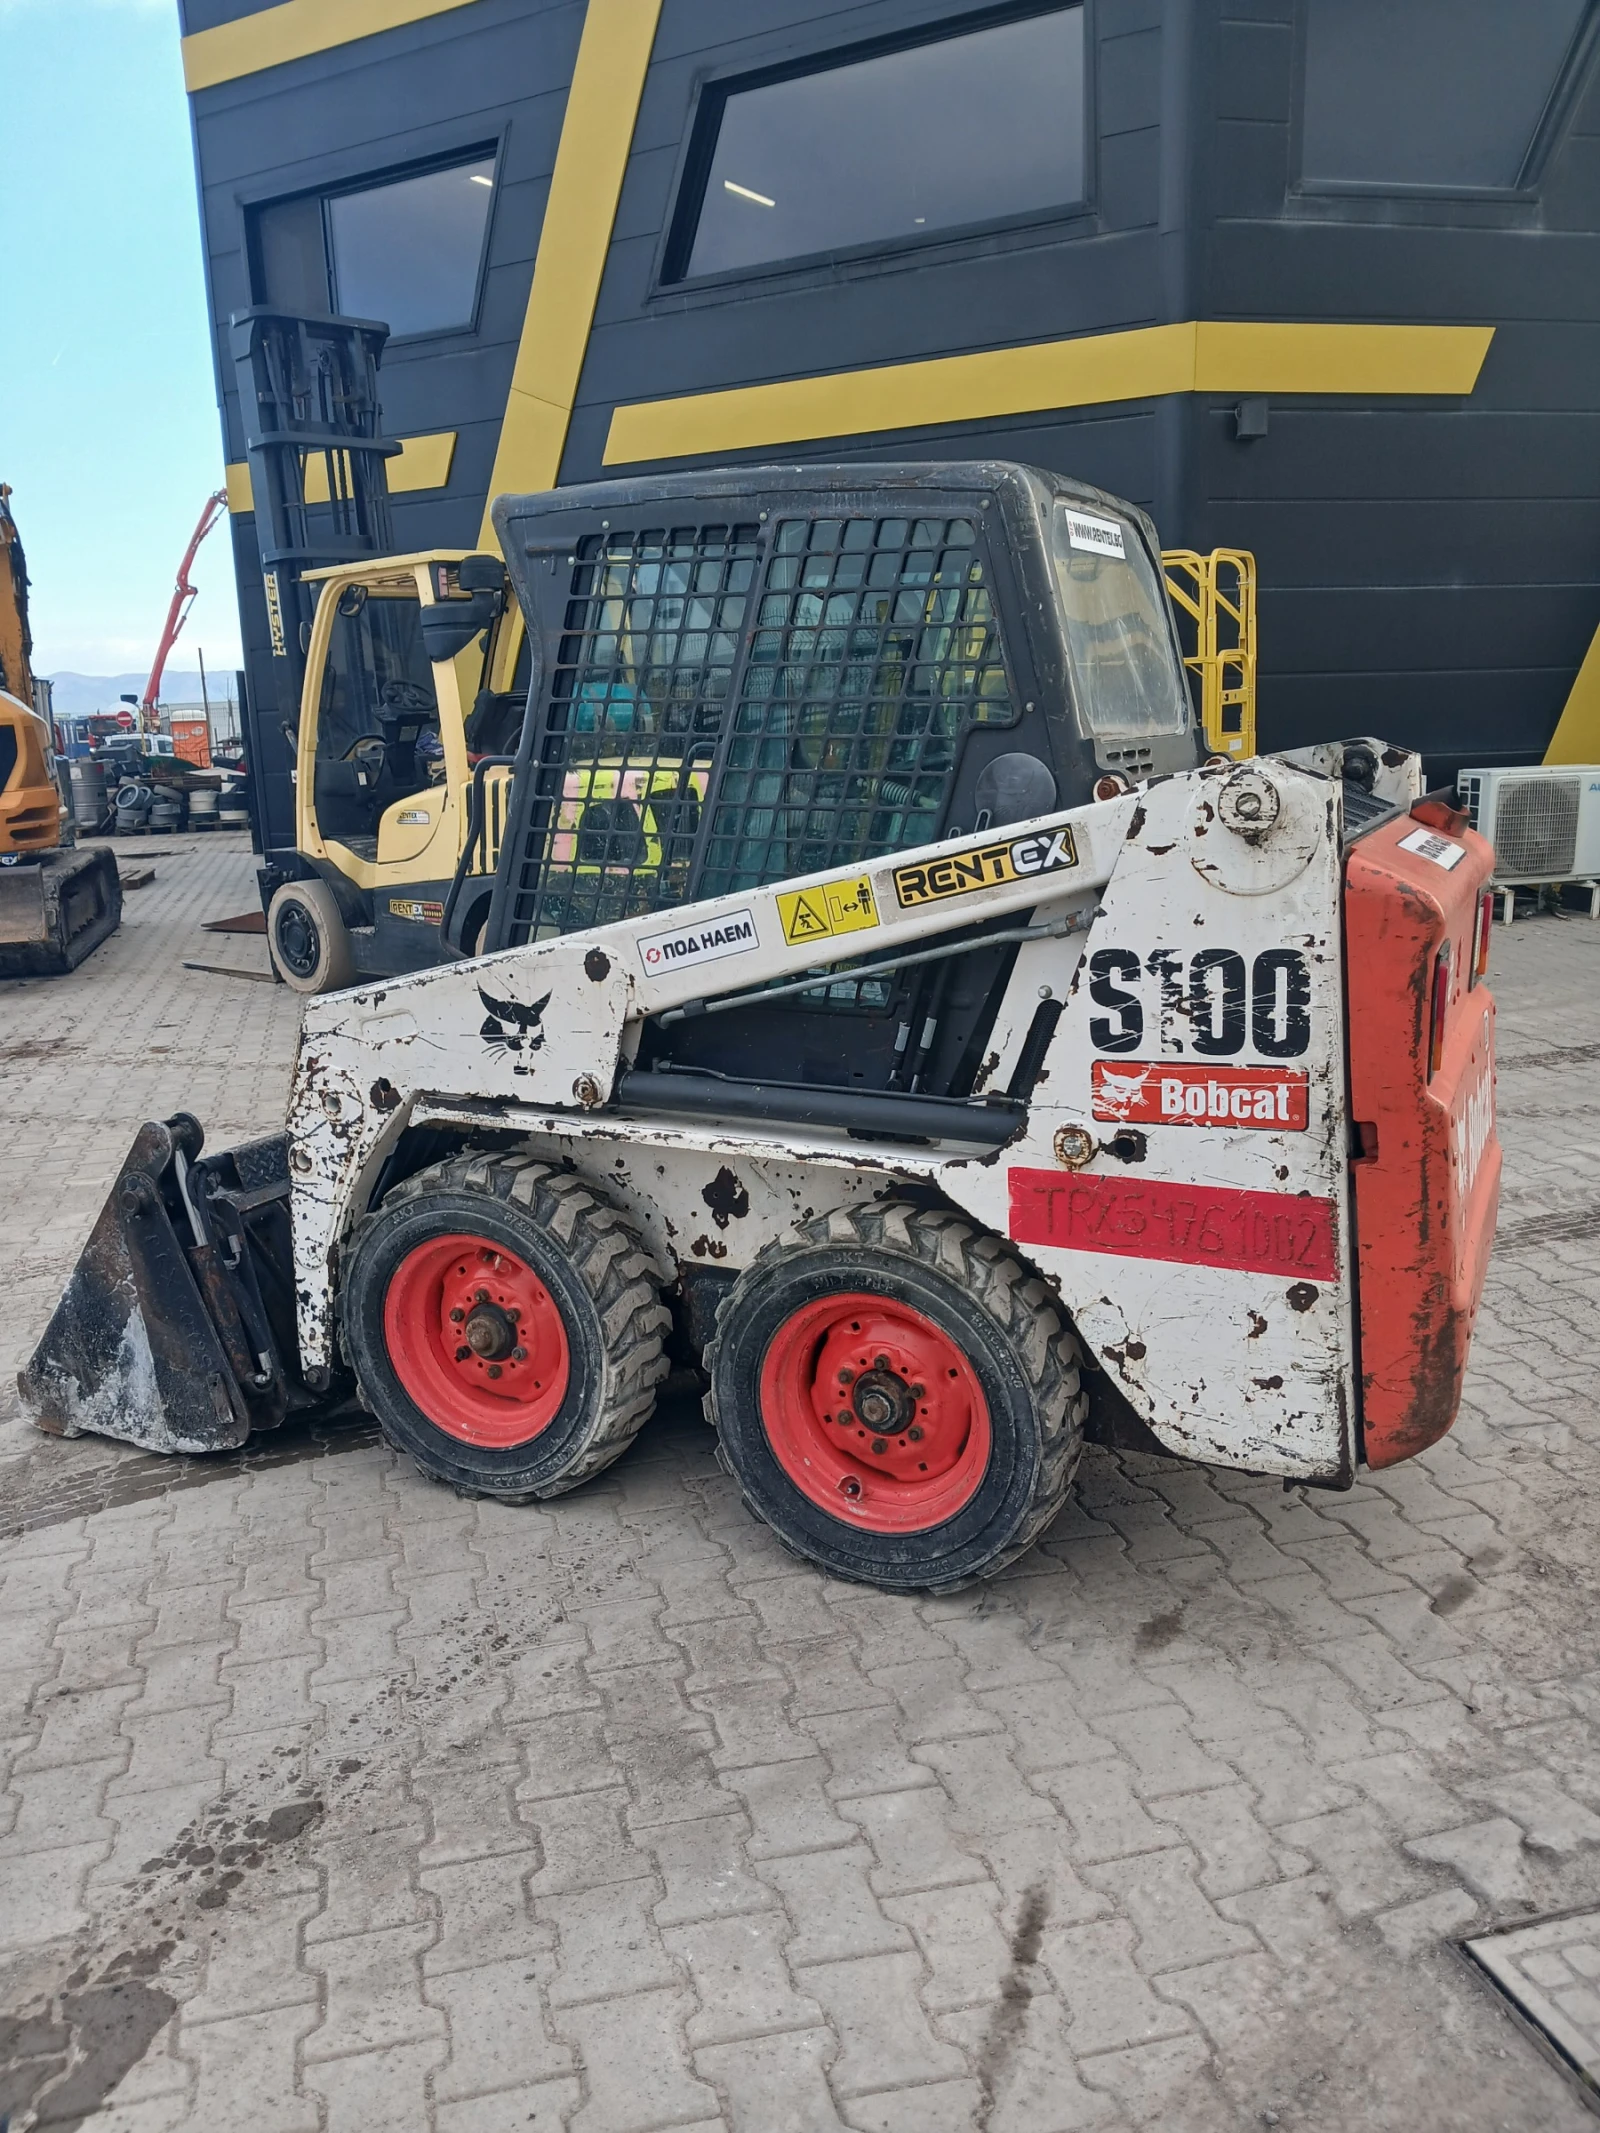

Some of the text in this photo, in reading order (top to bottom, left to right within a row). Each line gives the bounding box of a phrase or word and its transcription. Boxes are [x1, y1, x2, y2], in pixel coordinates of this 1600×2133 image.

[265, 573, 285, 656] HYSTER
[900, 832, 1071, 901] RENTEX
[392, 903, 423, 916] RENTEX
[662, 922, 752, 960] ПОД НАЕМ
[1089, 948, 1312, 1058] S100
[1161, 1078, 1290, 1121] Bobcat
